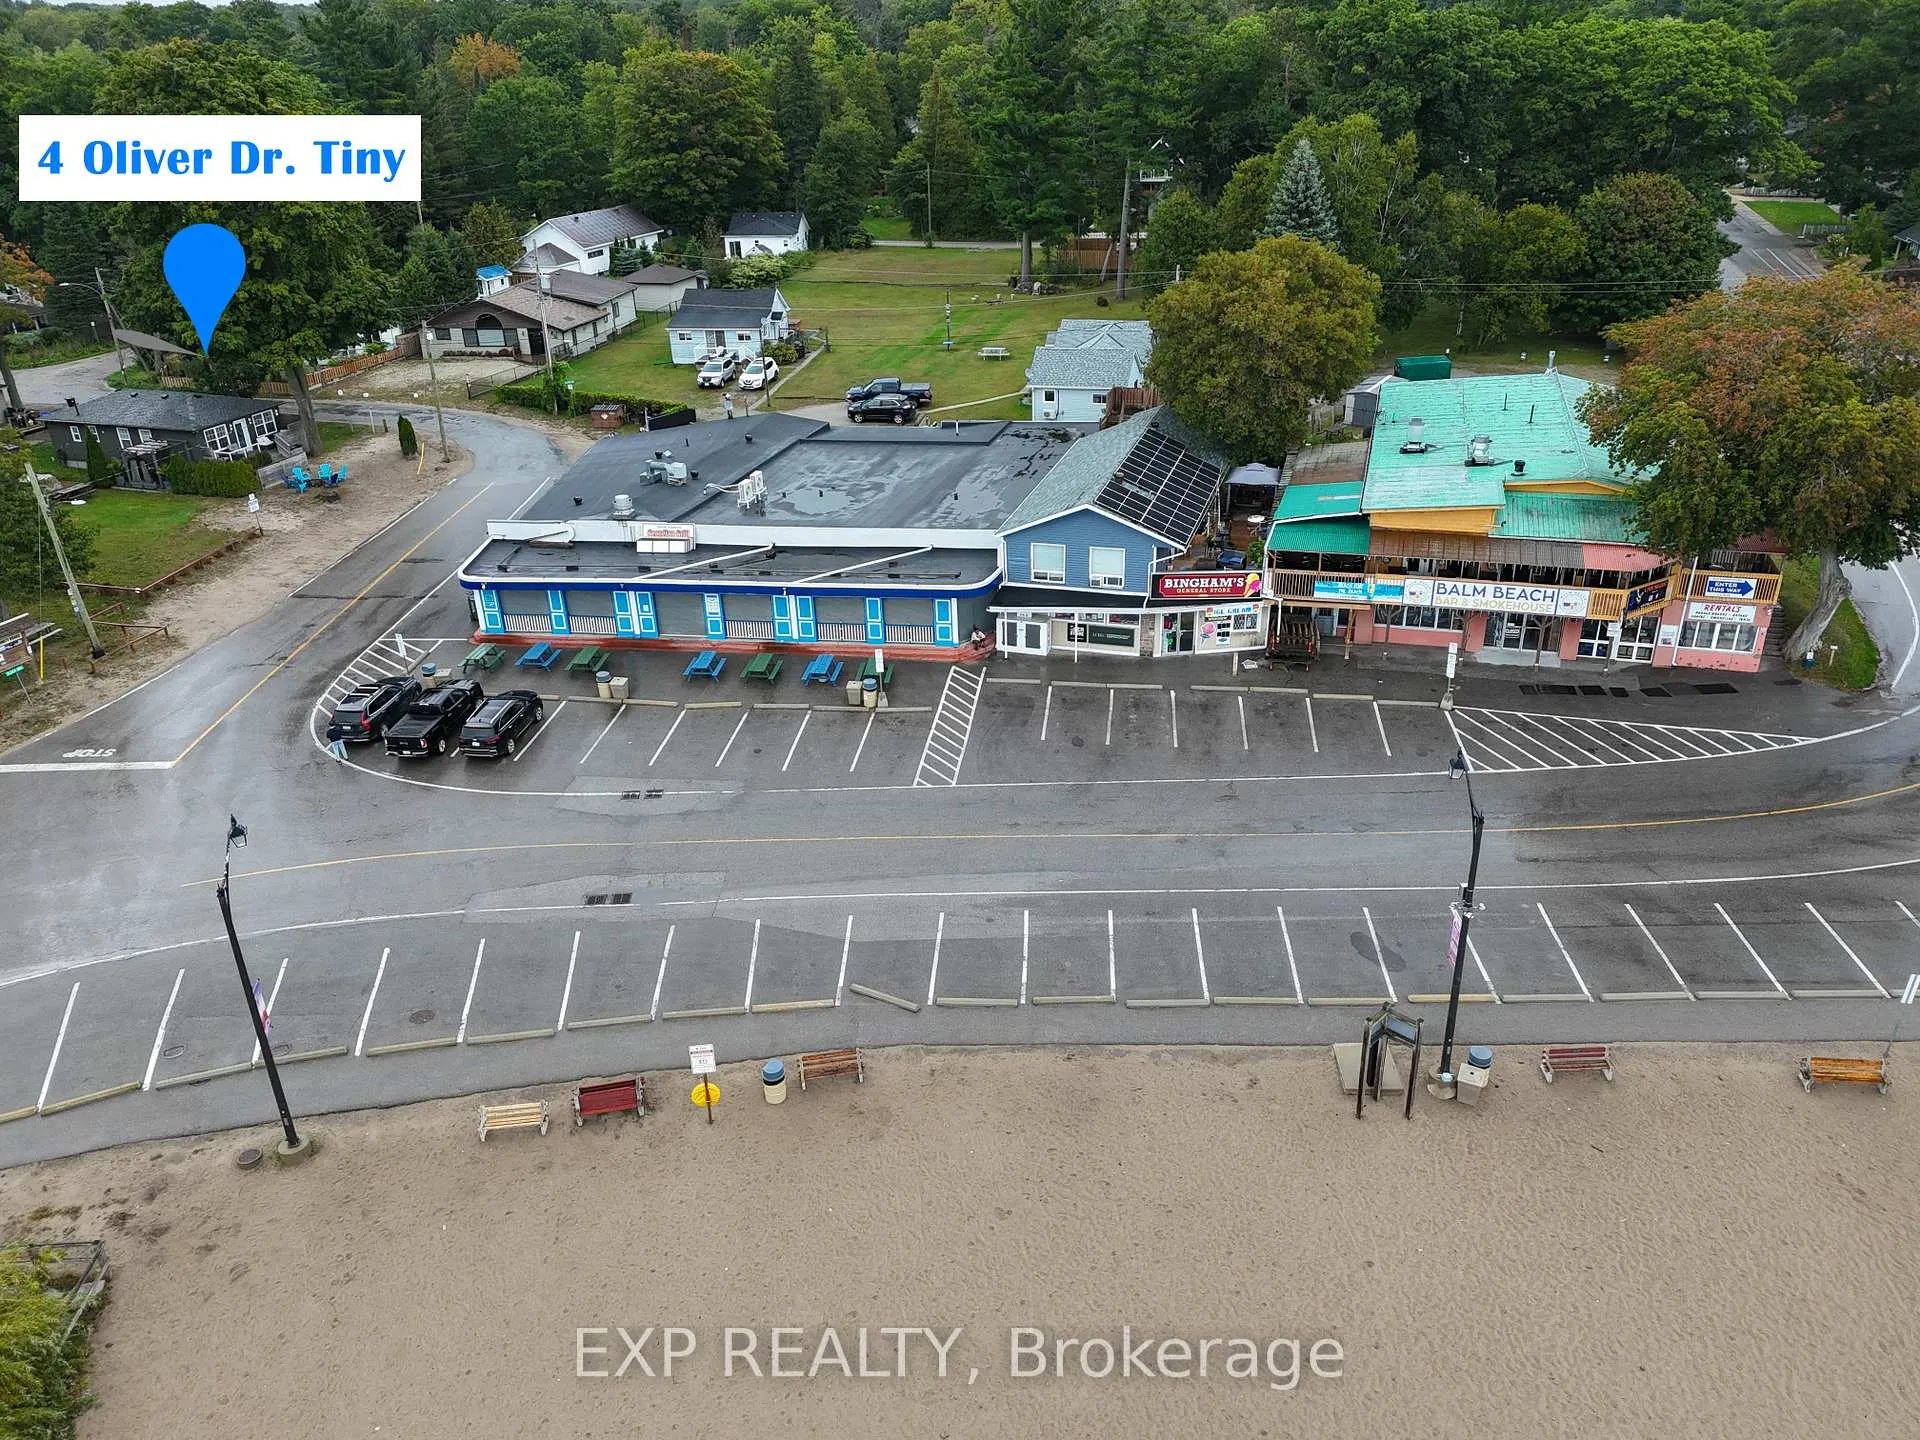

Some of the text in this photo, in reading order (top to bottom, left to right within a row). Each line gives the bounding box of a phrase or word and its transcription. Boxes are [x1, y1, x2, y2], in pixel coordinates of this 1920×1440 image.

[1164, 578, 1244, 588] BINGHAM'S
[1436, 582, 1487, 599] BALM
[1492, 586, 1557, 603] BEACH
[1435, 597, 1458, 607] BAR
[1461, 598, 1469, 607] &
[1472, 598, 1552, 613] SMOKEHOUSE
[1704, 604, 1742, 613] RENTALS
